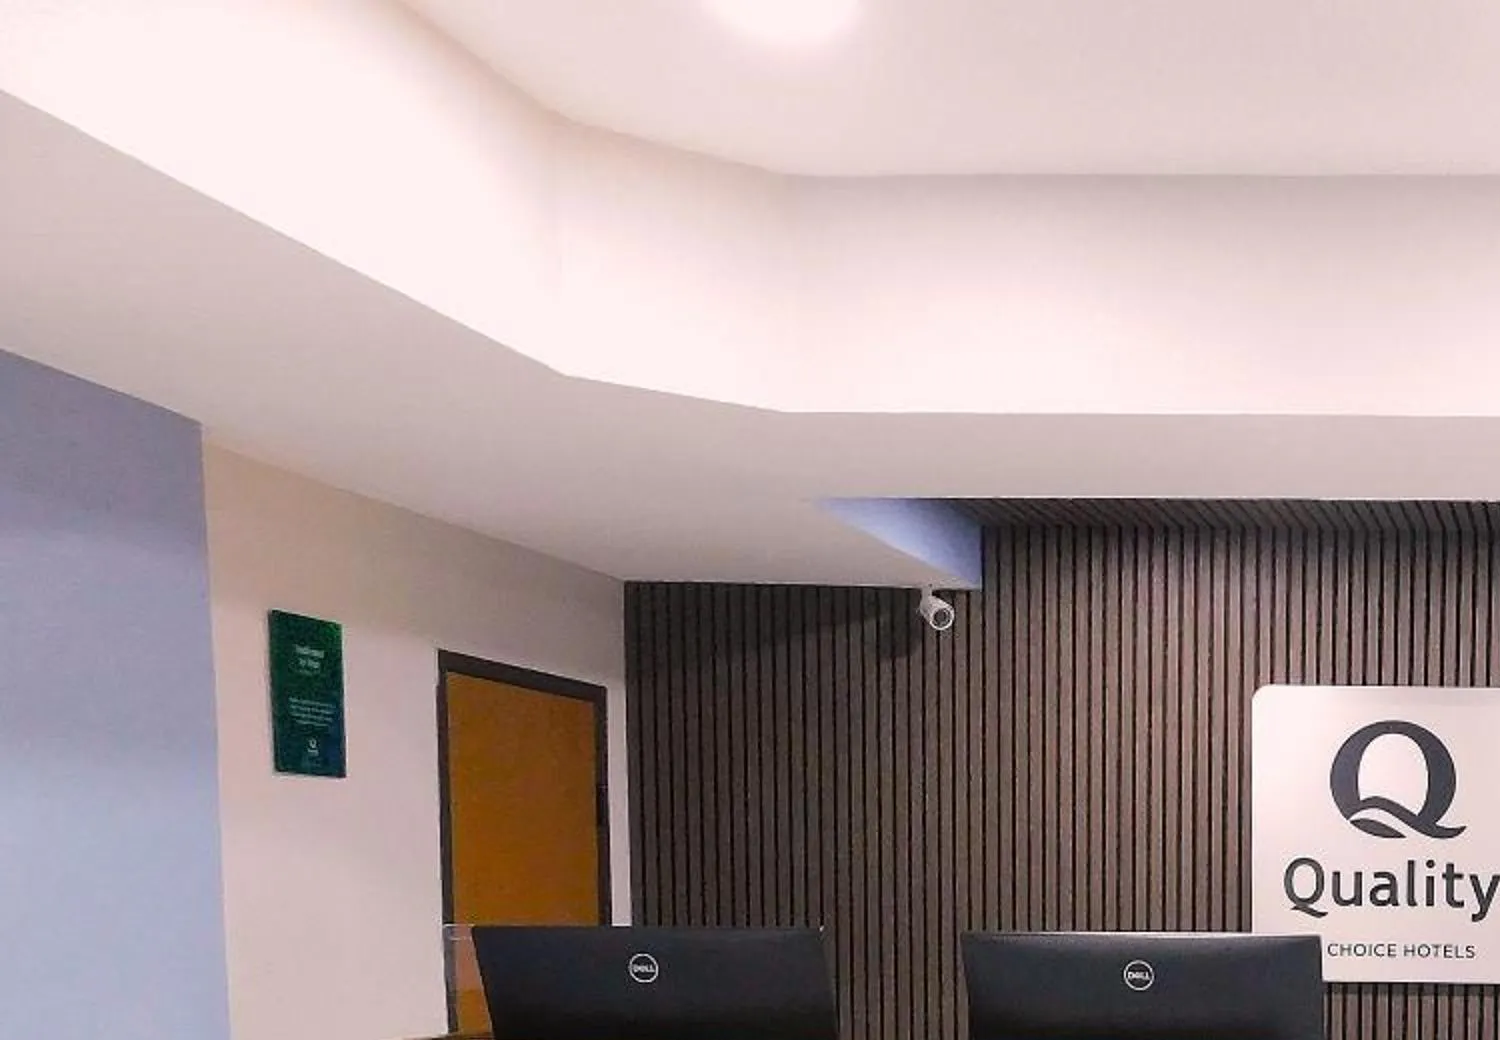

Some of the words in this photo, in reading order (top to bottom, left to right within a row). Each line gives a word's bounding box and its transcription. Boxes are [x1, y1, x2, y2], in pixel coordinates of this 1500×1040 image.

[1329, 719, 1467, 839] Q
[1327, 943, 1397, 957] CHOICE
[1403, 943, 1476, 959] HOTELS
[1128, 971, 1150, 981] DELL
